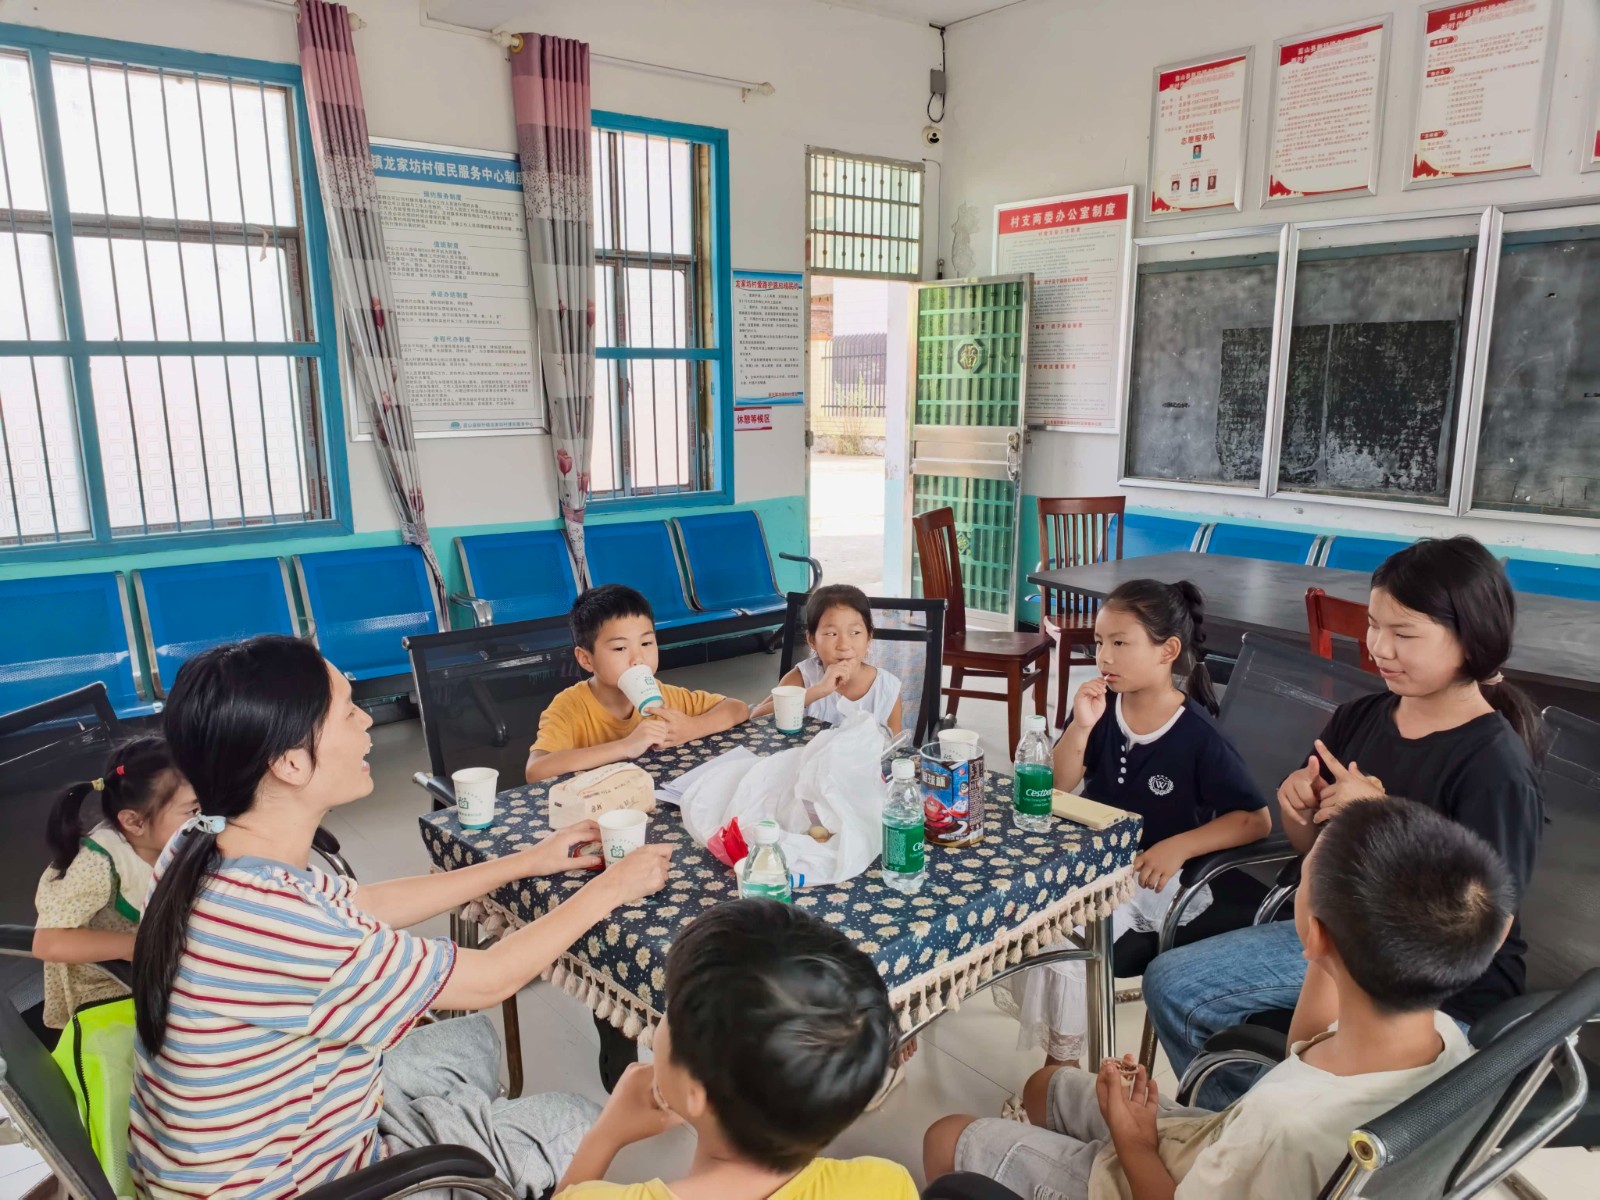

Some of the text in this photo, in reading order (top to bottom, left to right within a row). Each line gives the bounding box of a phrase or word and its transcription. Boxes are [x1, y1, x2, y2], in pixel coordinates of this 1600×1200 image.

[1010, 202, 1117, 228] 村支两委办公室制度
[737, 413, 770, 424] 休憩等候区
